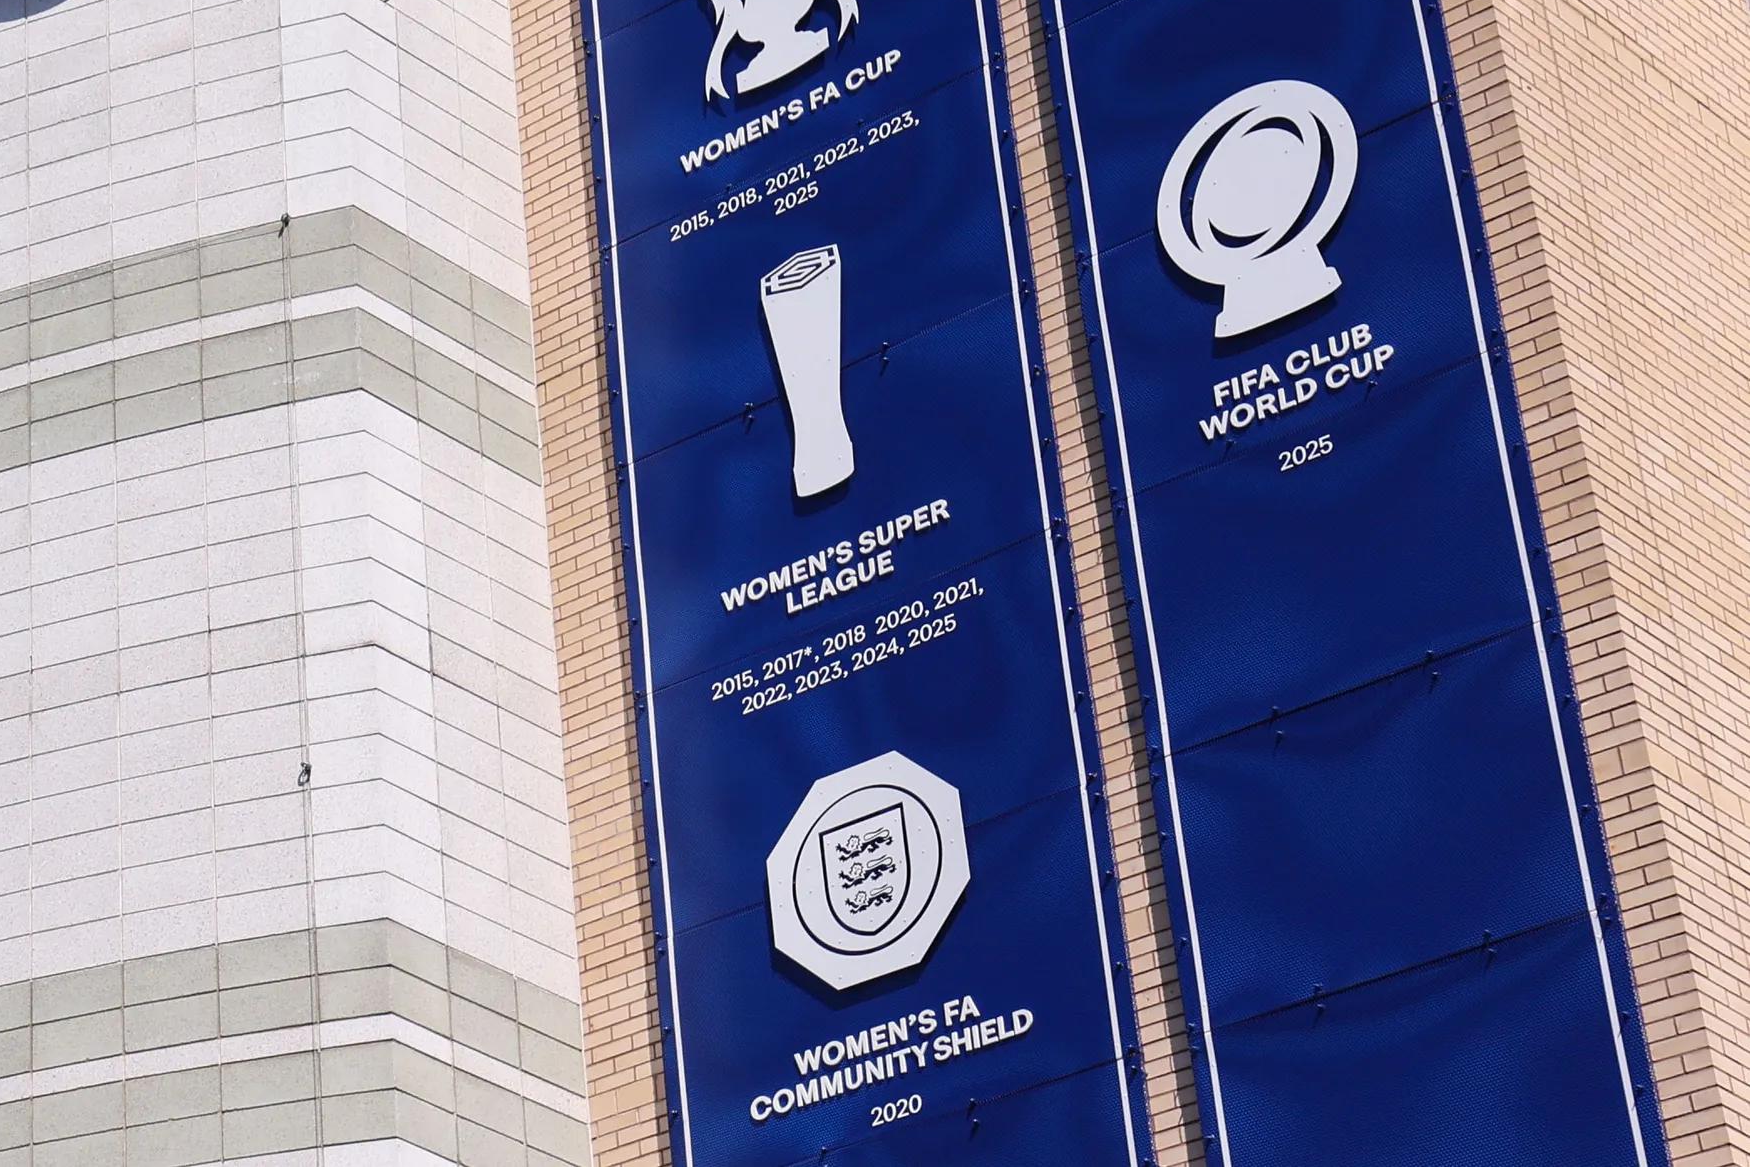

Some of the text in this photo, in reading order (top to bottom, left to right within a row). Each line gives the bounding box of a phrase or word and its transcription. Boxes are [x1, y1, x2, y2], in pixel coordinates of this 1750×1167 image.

[680, 49, 901, 174] WOMEN'S FA CUP
[669, 110, 920, 242] 2015, 2018, 2021, 2022, 2023,
[774, 181, 819, 216] 2025
[1198, 344, 1395, 441] WORLD CUP
[1213, 323, 1373, 408] FIFA CLUB
[1278, 434, 1334, 471] 2025
[720, 498, 951, 612] WOMEN'S SUPER
[786, 550, 895, 614] LEAGUE
[711, 669, 759, 701] 2015,
[822, 624, 866, 656] 2018
[875, 600, 930, 635] 2020,
[932, 577, 984, 611] 2021,
[742, 614, 957, 715] 2022, 2023, 2024, 2025
[750, 1008, 1034, 1122] COMMUNITY SHIELD
[793, 994, 981, 1076] WOMEN'S FA
[870, 1094, 923, 1127] 2020
